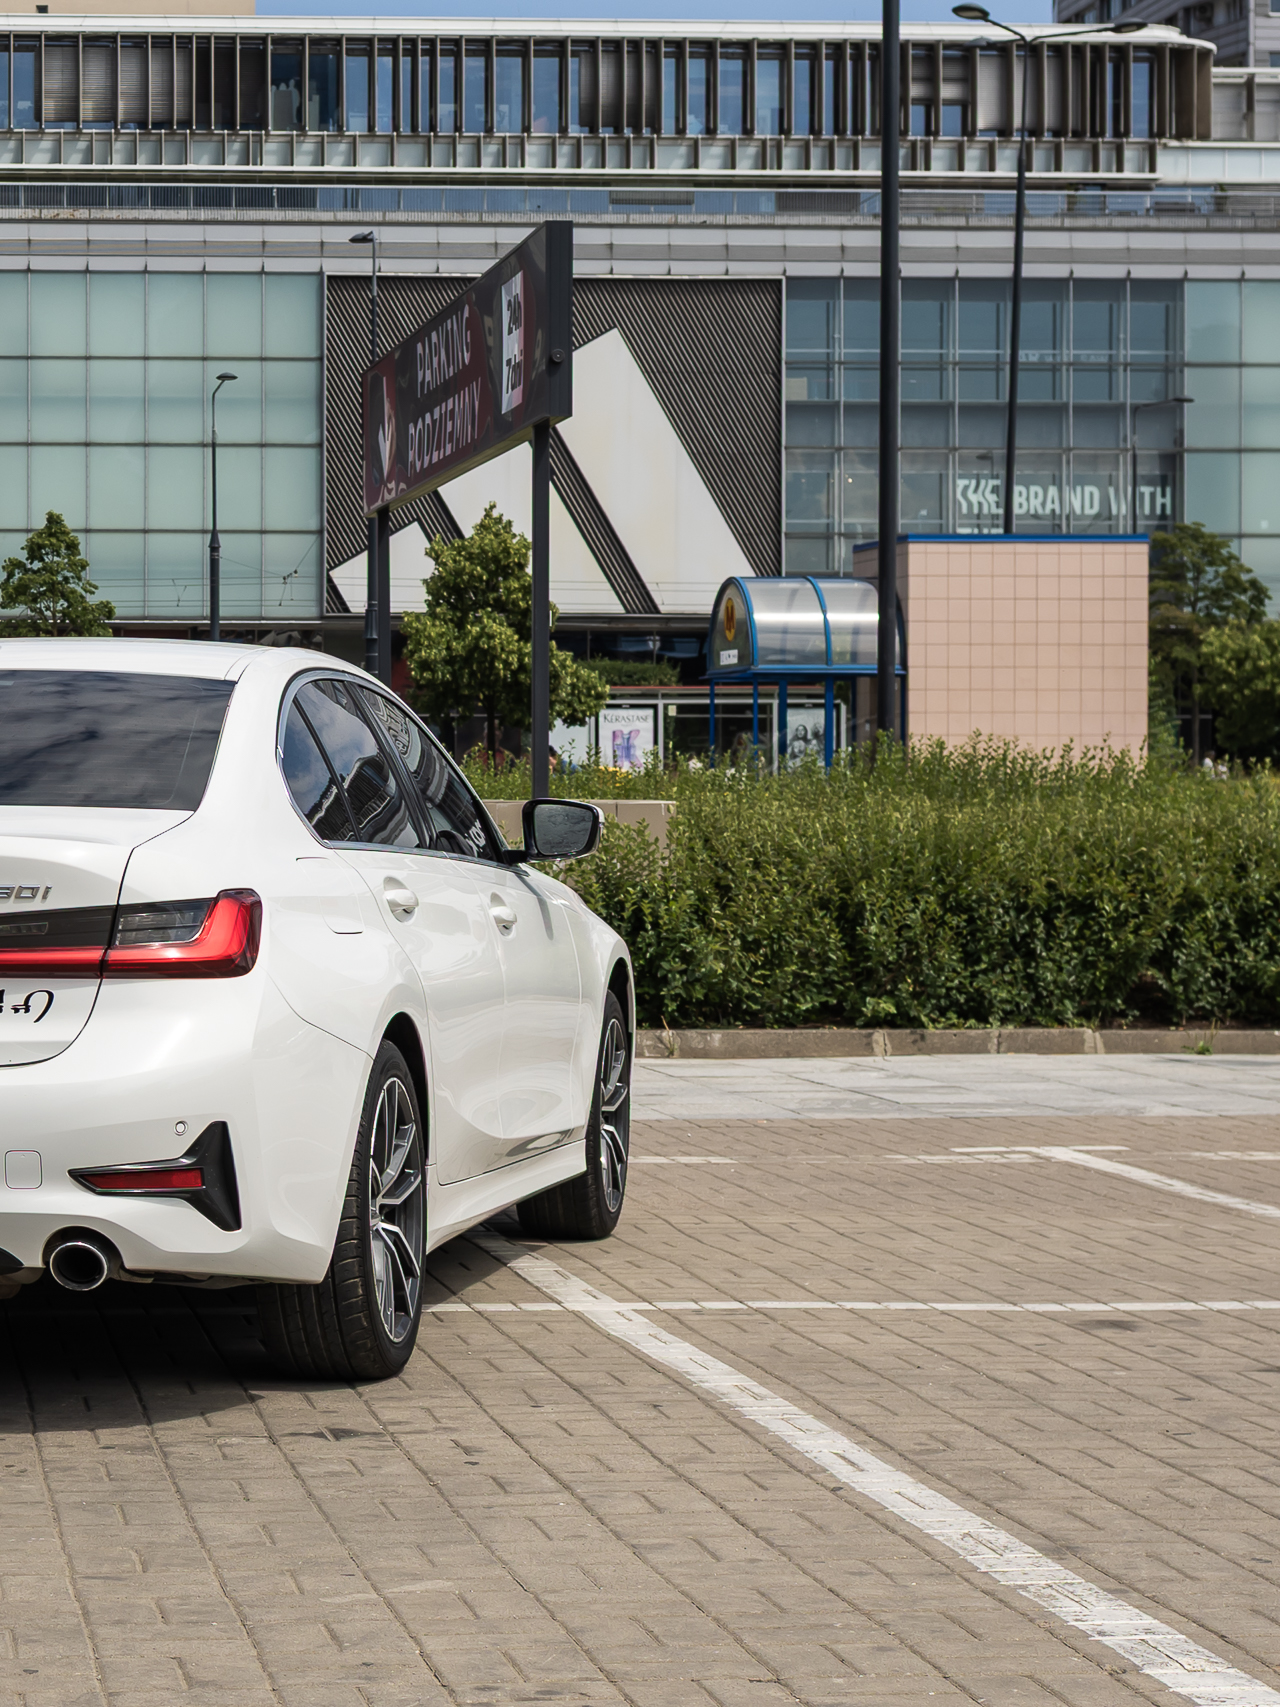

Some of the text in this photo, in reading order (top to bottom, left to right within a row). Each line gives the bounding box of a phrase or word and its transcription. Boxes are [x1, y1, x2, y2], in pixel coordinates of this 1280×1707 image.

[507, 293, 523, 336] 24h
[416, 304, 472, 398] PARKING
[408, 377, 481, 477] PODZIEMNY
[1014, 484, 1101, 516] BRAND
